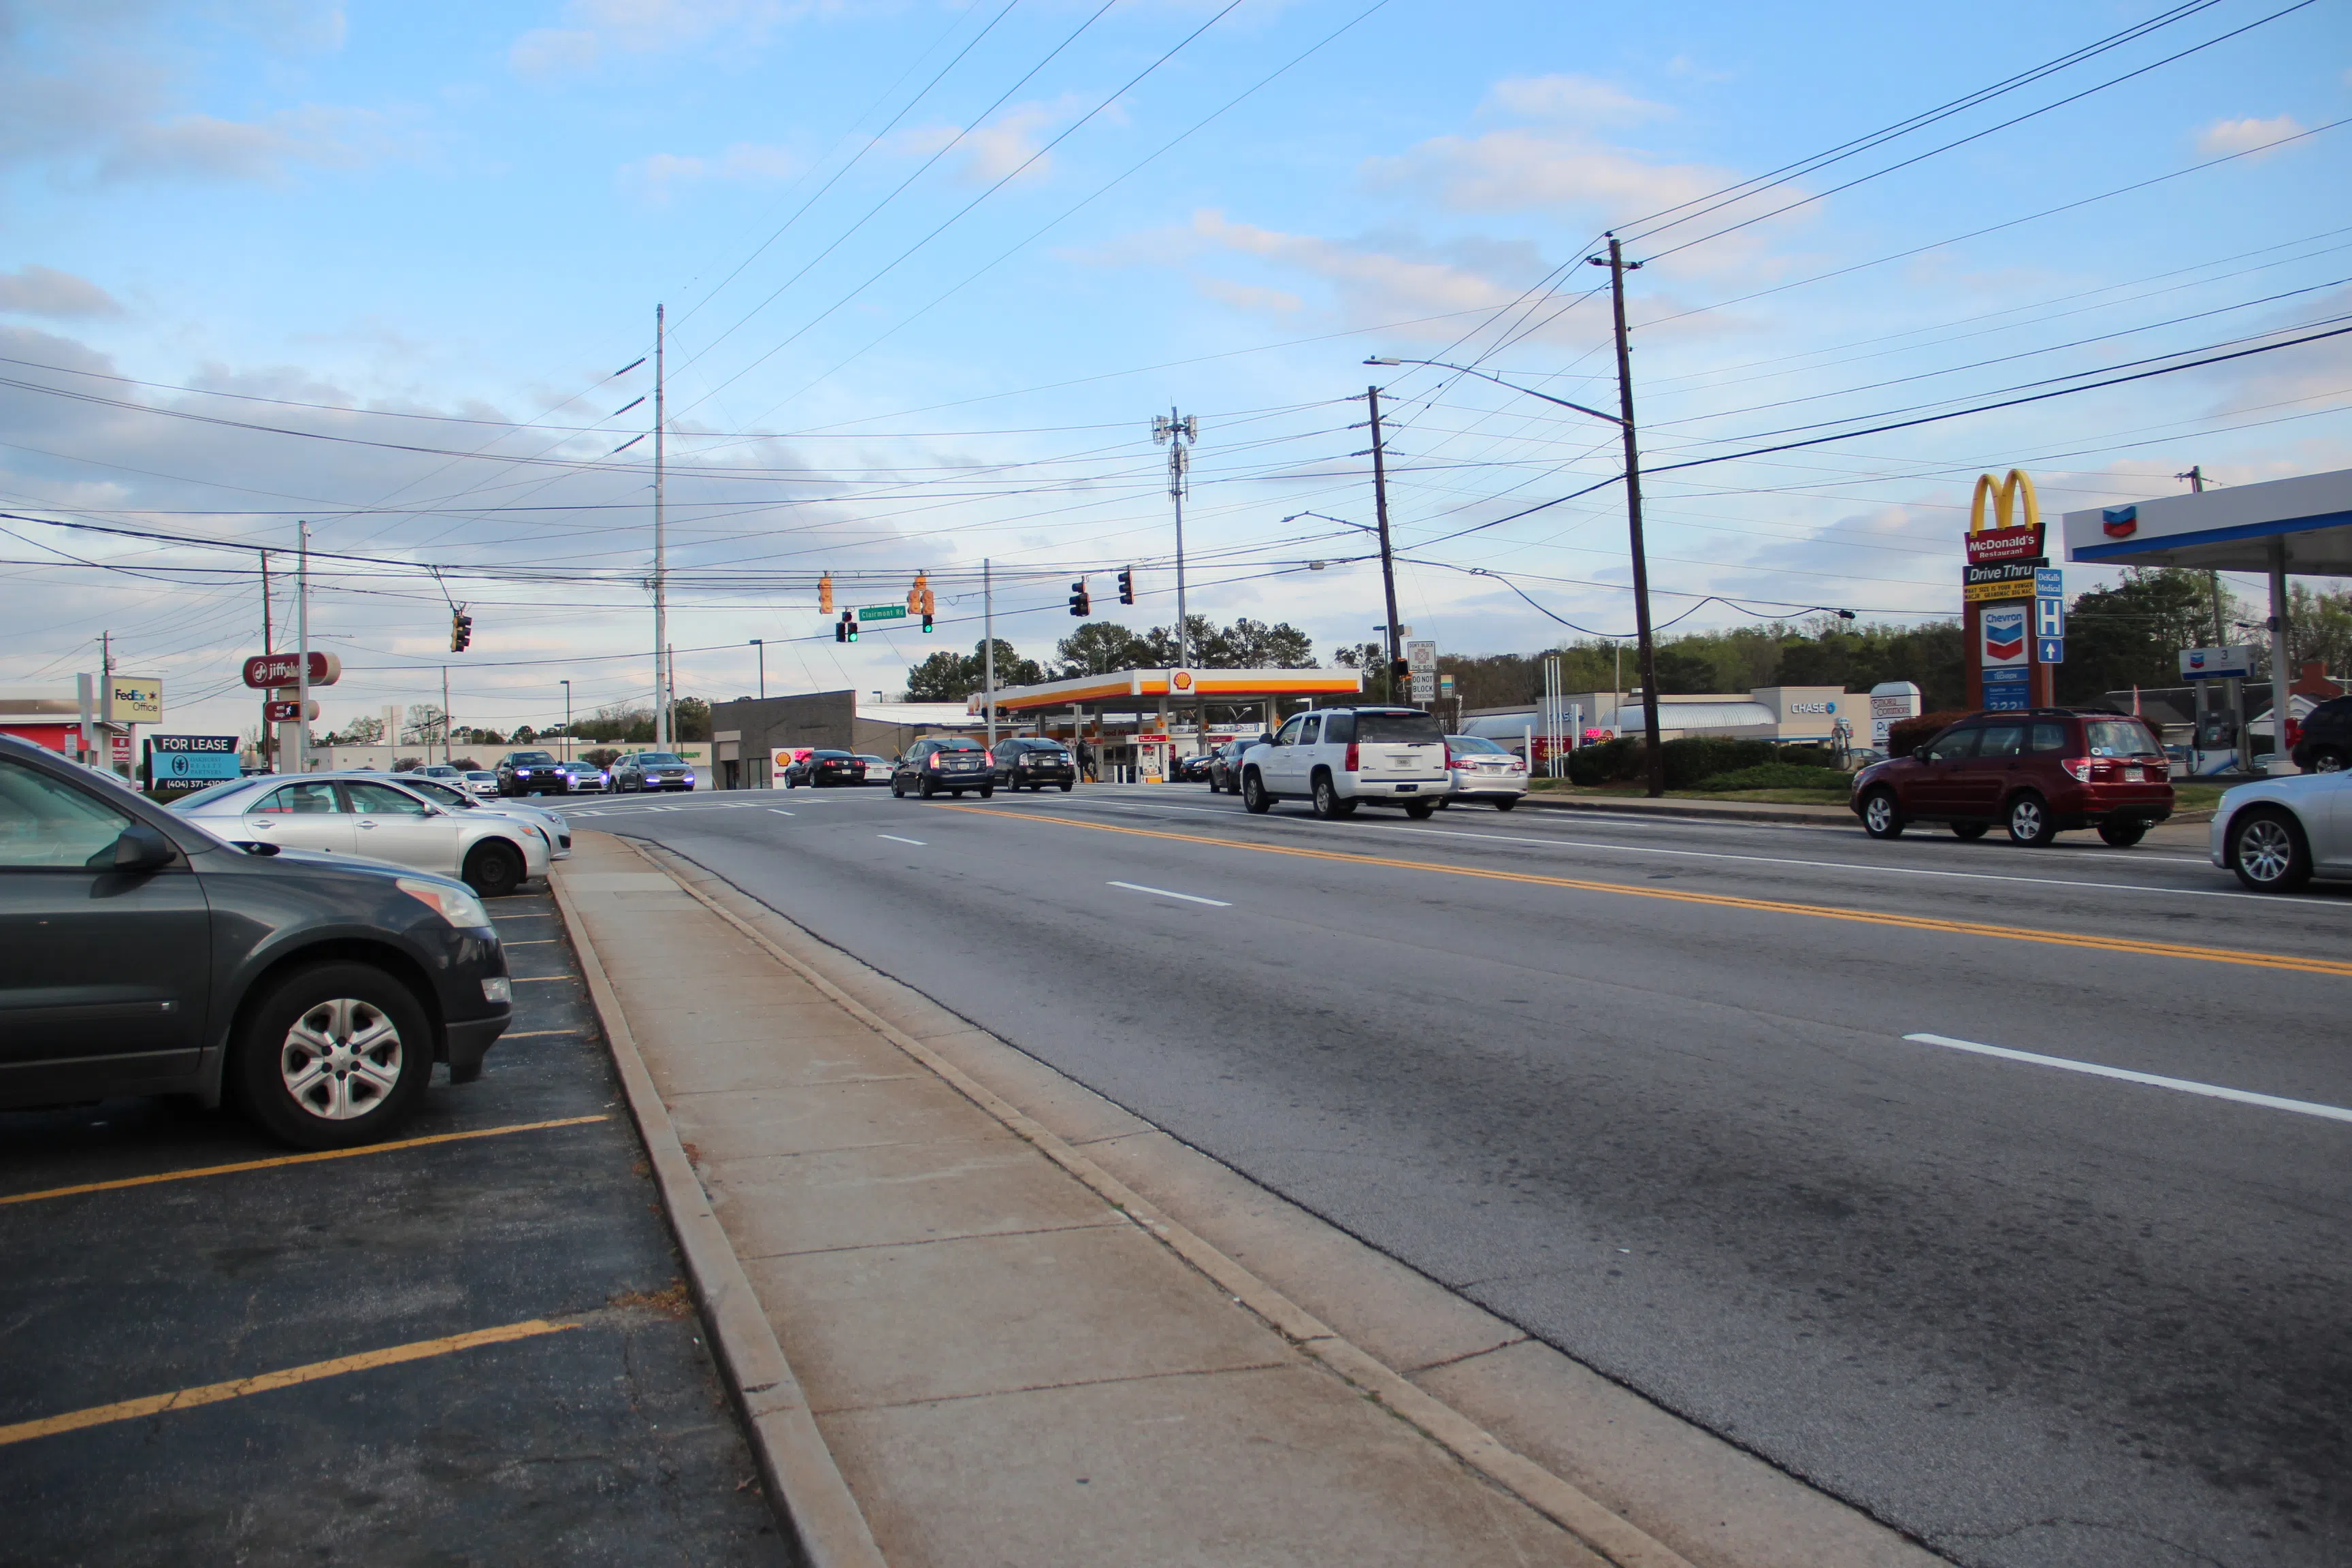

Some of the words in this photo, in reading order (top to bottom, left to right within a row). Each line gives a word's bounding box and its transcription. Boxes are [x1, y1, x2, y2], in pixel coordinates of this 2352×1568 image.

[1969, 535, 2034, 552] McDonald's
[1979, 548, 2023, 558] Restaurant
[1970, 567, 2002, 581] Drive
[2003, 564, 2032, 578] Thru
[2038, 573, 2060, 581] DeKalb
[2038, 584, 2061, 592] Medical
[1986, 613, 2023, 623] Chevron
[2040, 600, 2060, 635] H
[2221, 649, 2228, 659] 3
[115, 689, 146, 701] FedEx
[133, 702, 158, 712] Office
[1791, 702, 1826, 713] CHASE
[163, 738, 189, 750] FOR
[191, 739, 229, 750] LEASE
[167, 780, 189, 788] (404)
